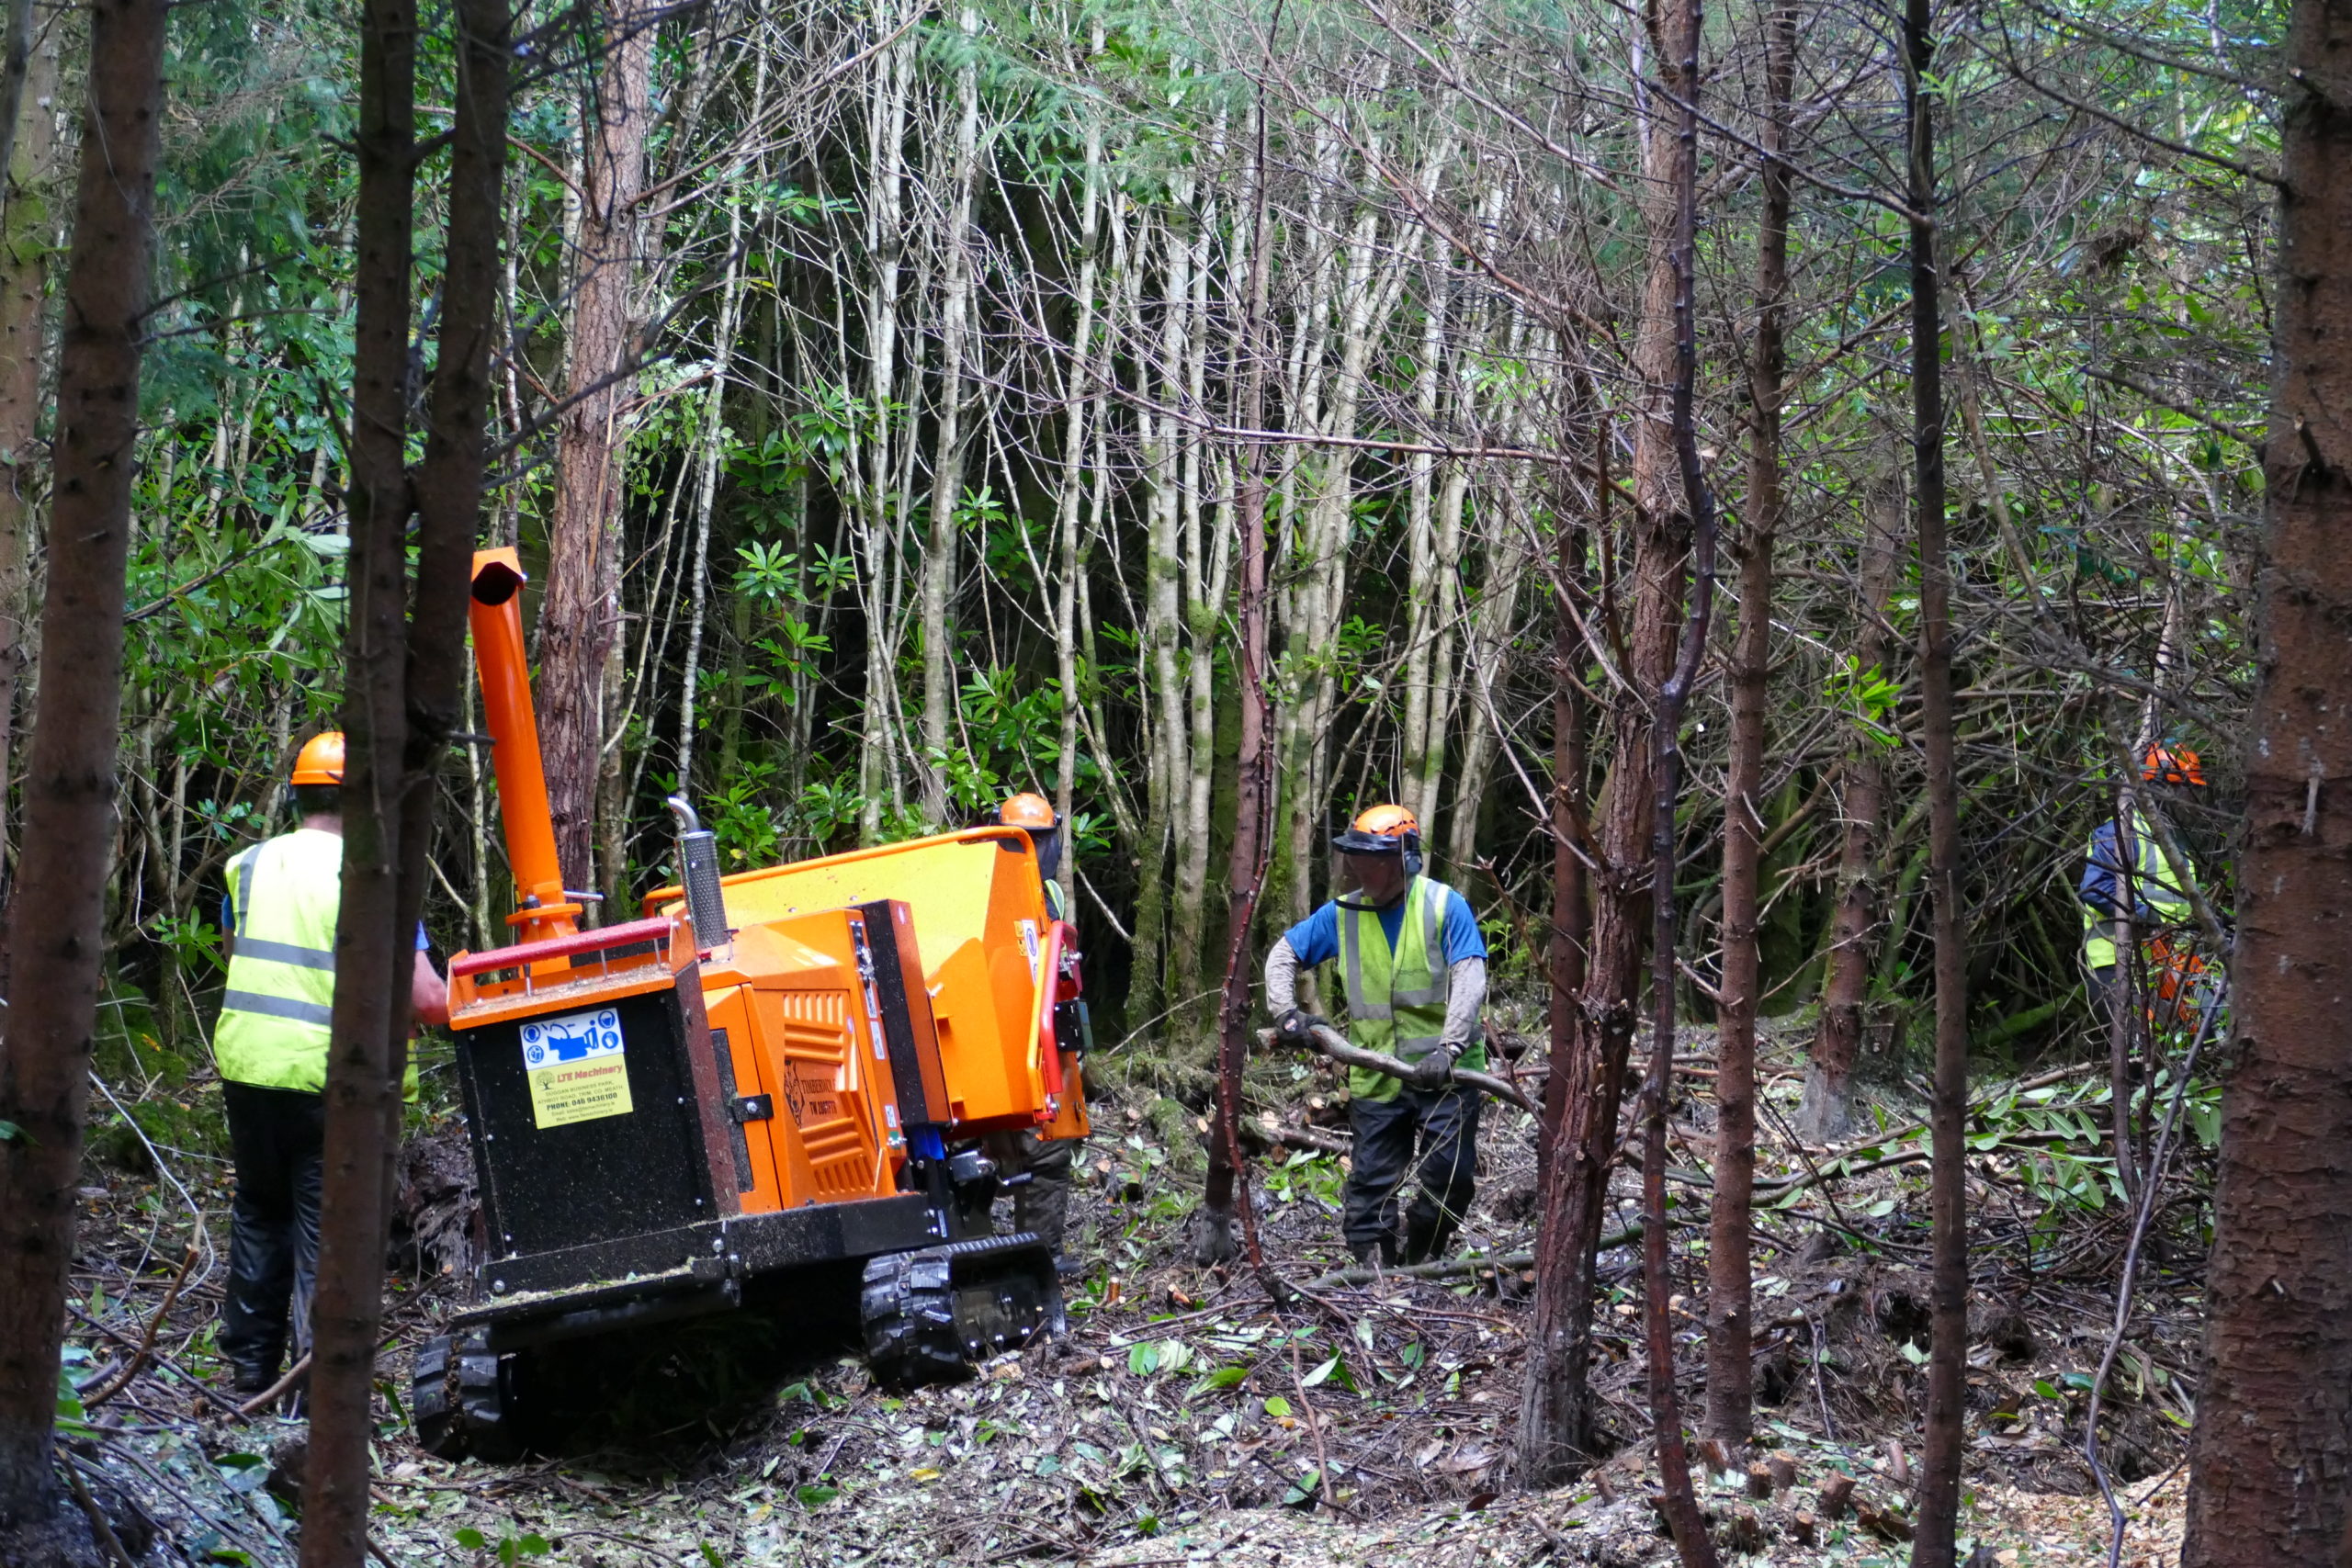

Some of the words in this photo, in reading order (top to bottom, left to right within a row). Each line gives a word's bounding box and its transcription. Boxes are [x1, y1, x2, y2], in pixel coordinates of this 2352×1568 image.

[557, 1072, 573, 1083] LTE
[574, 1065, 623, 1079] Machinery
[570, 1083, 597, 1092] BUSINESS
[571, 1098, 586, 1106] 046
